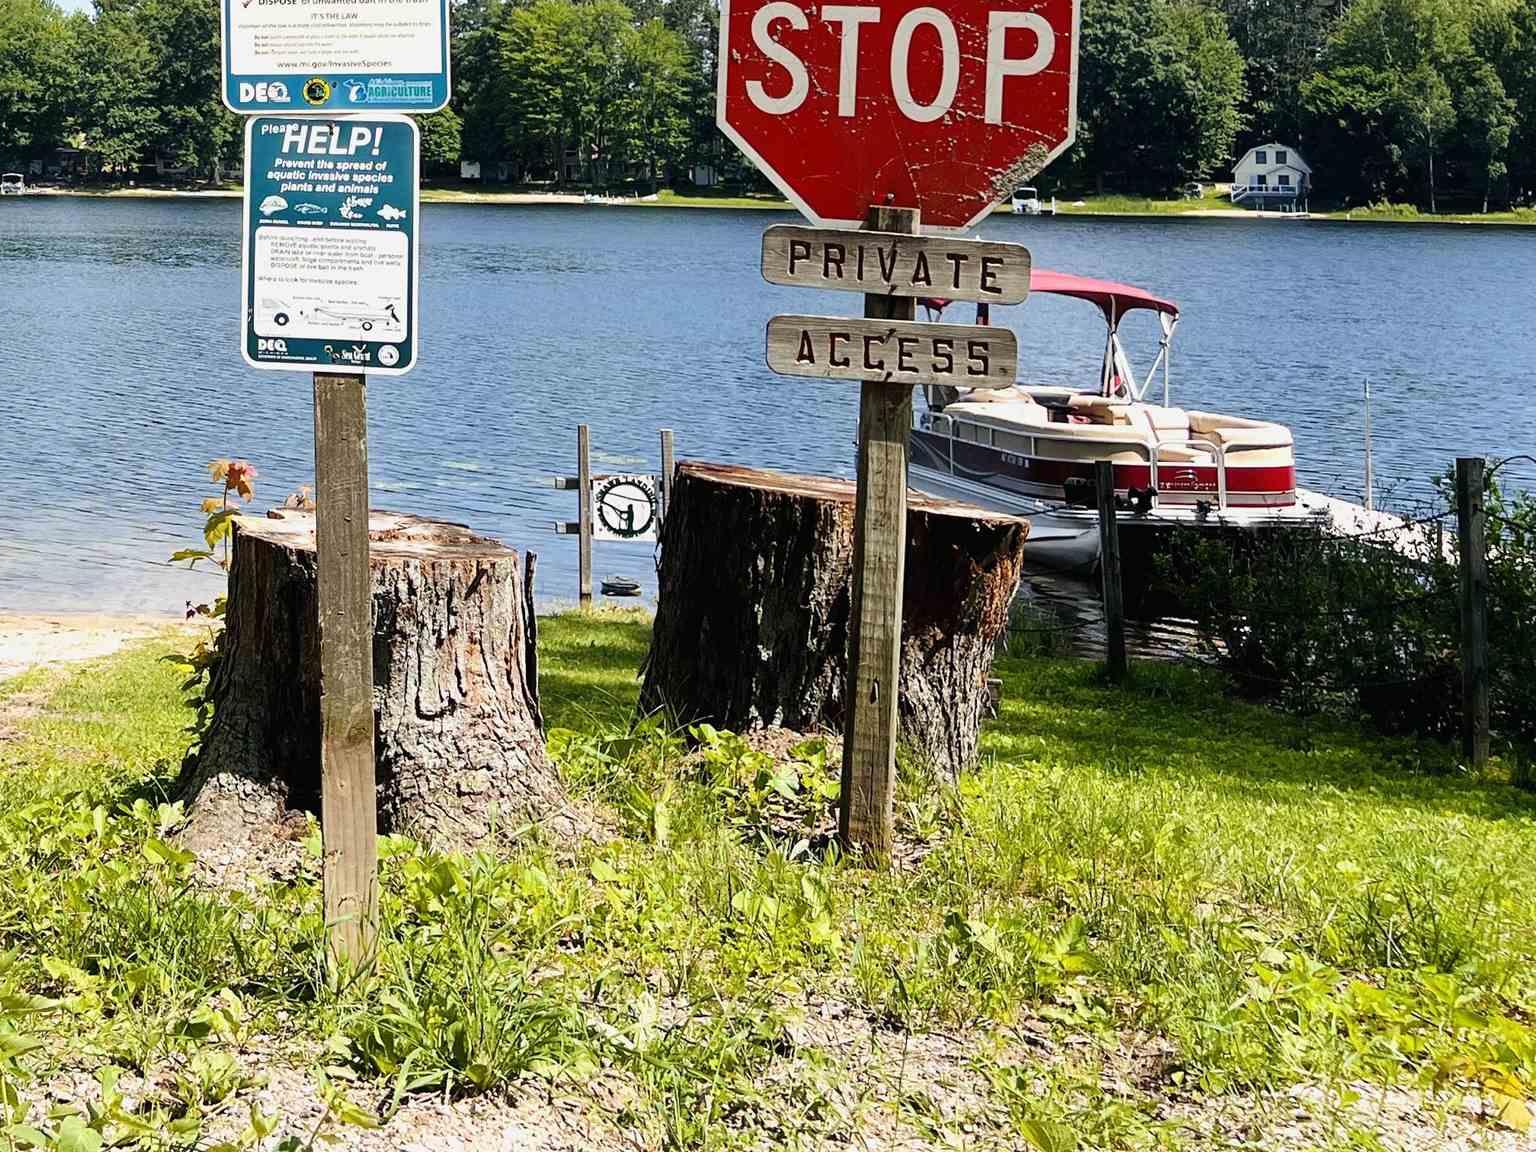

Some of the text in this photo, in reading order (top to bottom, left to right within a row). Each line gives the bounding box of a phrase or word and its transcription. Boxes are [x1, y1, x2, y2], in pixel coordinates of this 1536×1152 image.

[746, 1, 1056, 125] STOP
[239, 81, 292, 103] DEQ
[367, 86, 432, 97] AGRICULTURE
[281, 124, 383, 155] HELP!
[274, 157, 387, 171] Prevent the spread of
[267, 169, 393, 184] aquatic invasive species
[280, 181, 379, 194] plants and animals
[787, 239, 1005, 295] PRIVATE
[795, 329, 990, 376] ACCESS
